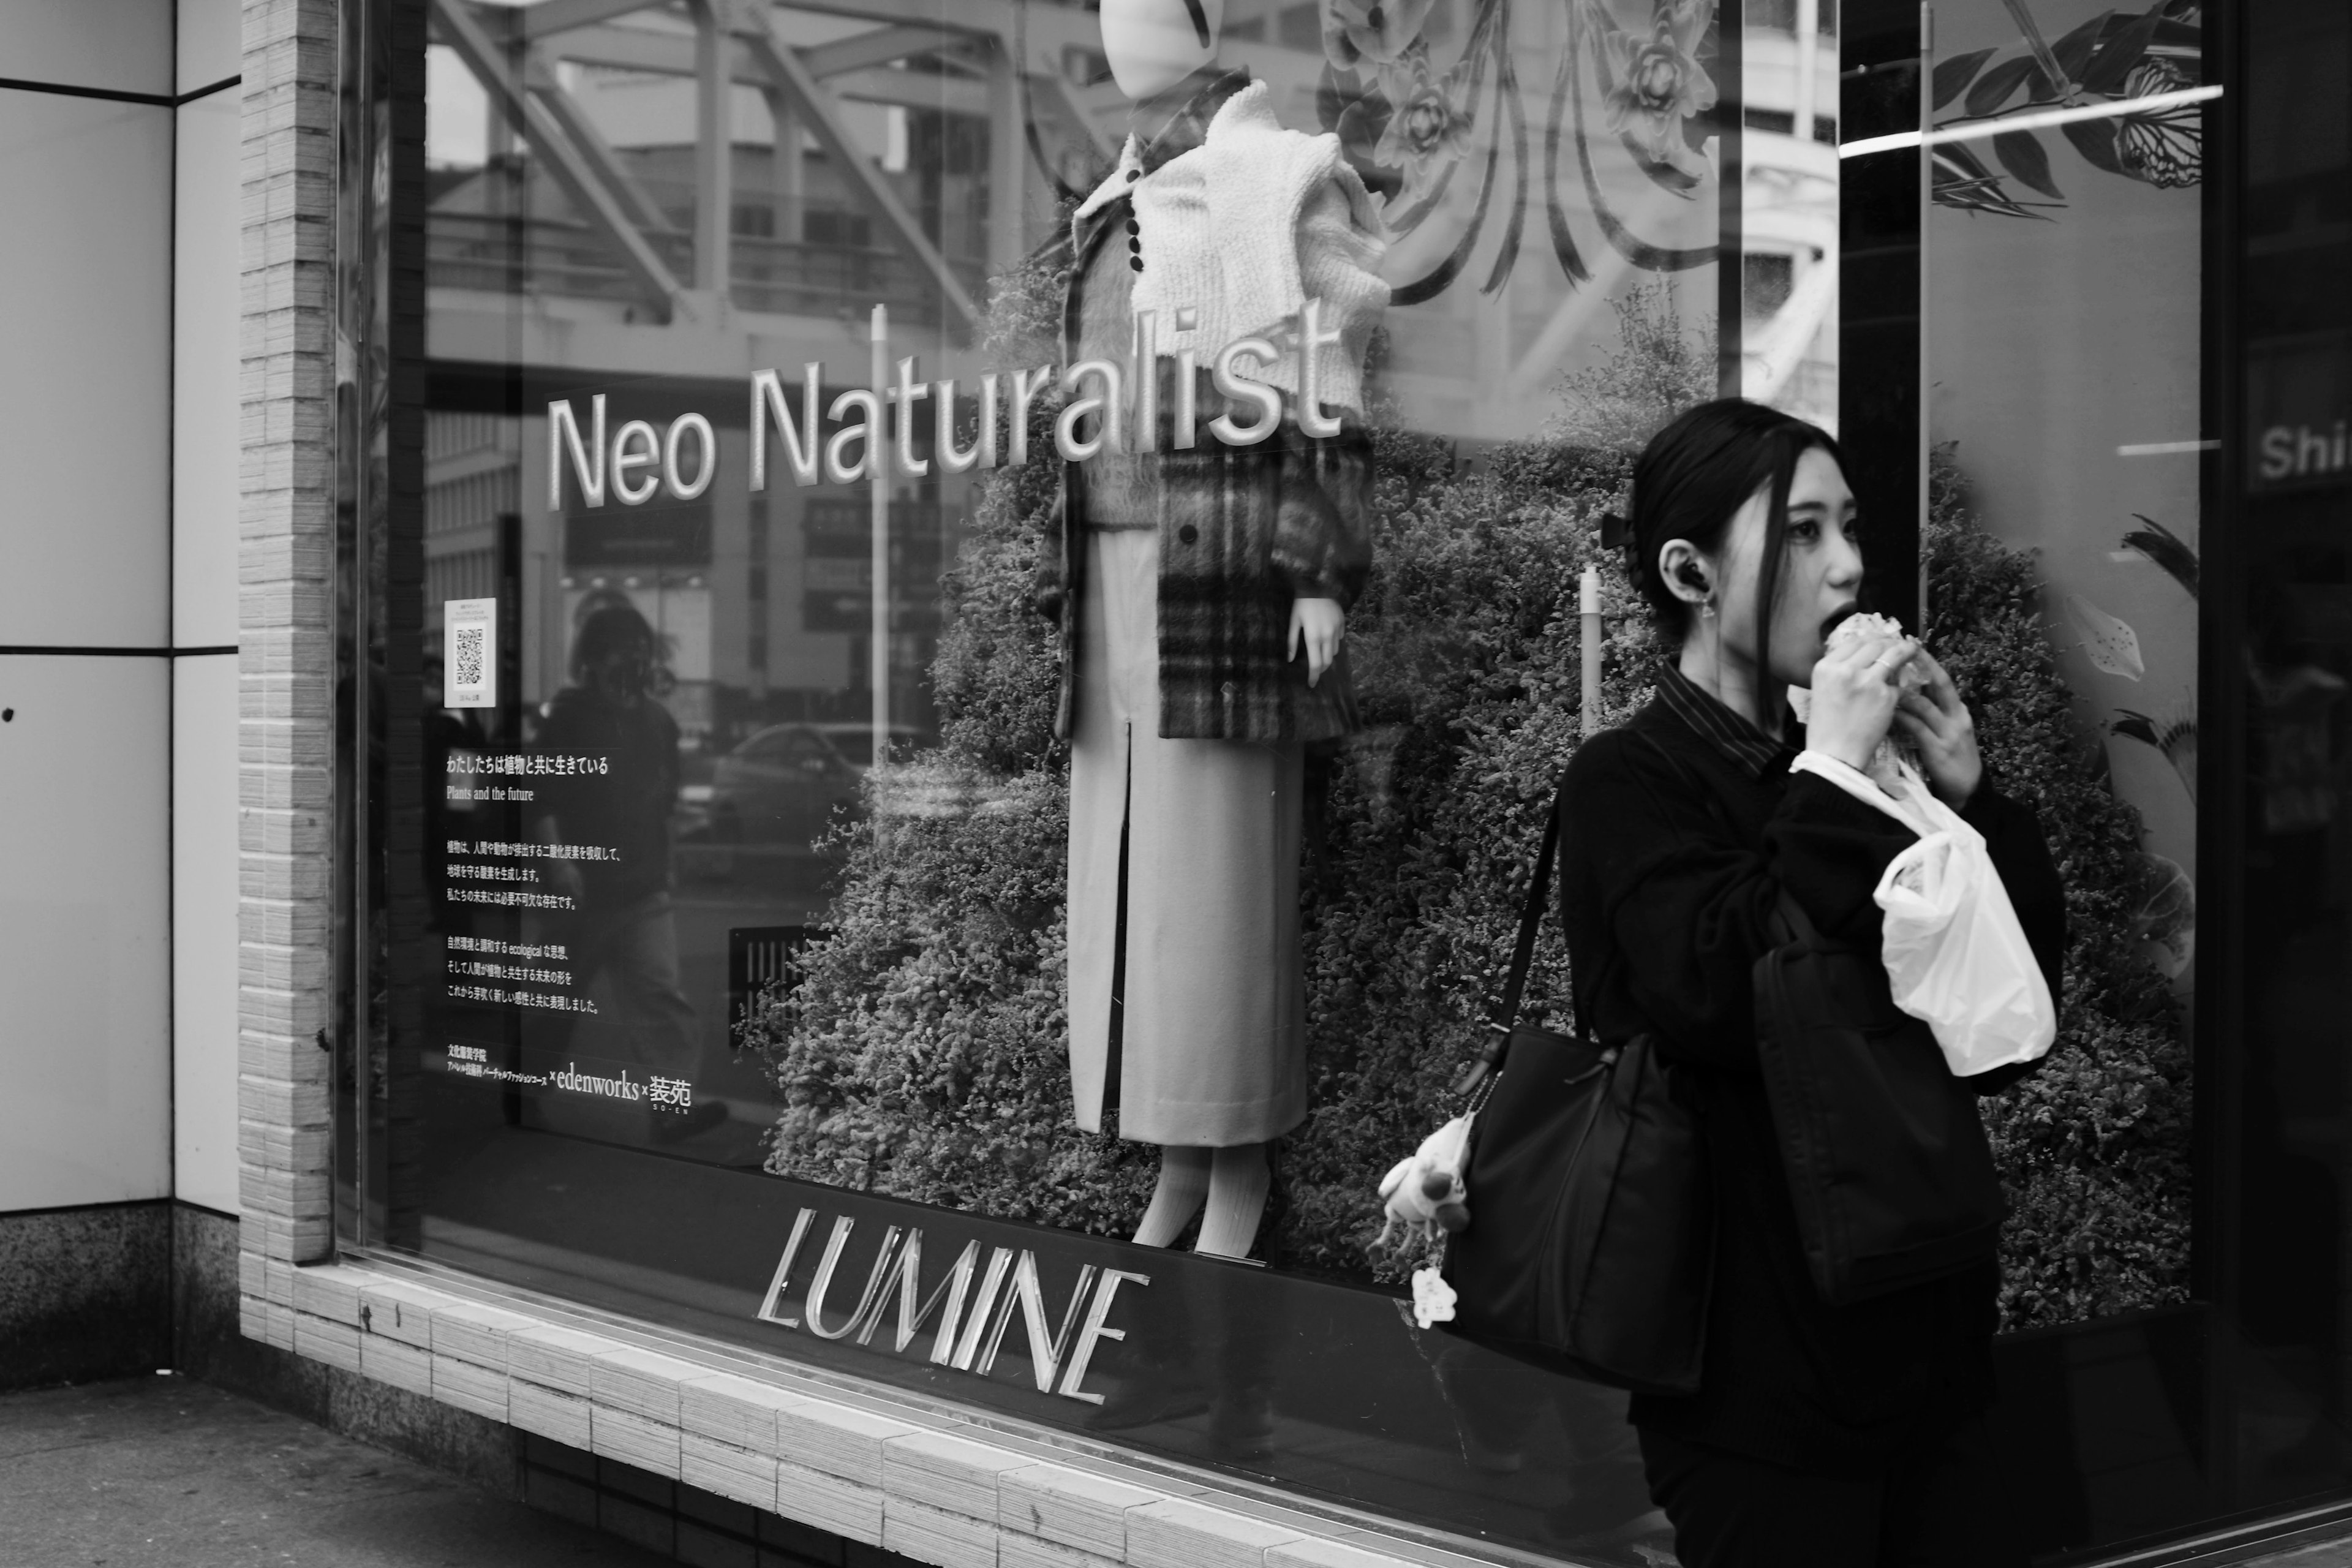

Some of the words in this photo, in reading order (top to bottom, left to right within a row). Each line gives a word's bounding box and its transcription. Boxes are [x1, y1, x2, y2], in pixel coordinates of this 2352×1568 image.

[548, 393, 716, 511] Neo
[749, 296, 1341, 492] Naturalist
[2259, 420, 2352, 478] Shi
[446, 755, 608, 775] わたしたちは植物と共に生きている
[447, 785, 472, 800] Plants
[473, 786, 489, 801] and
[492, 786, 505, 801] the
[508, 786, 533, 801] future
[447, 864, 539, 883] 地球を守る酸素を生成します。
[447, 888, 576, 910] 私たちの未来には必要不可欠な存在です。
[509, 943, 542, 959] ecological
[448, 960, 572, 986] そして人間が植物と共生する未来の形を
[557, 1061, 639, 1101] edenworks
[650, 1076, 692, 1107] 装苑
[653, 1104, 688, 1115] SO-EN
[758, 1207, 1150, 1405] LUMINE
